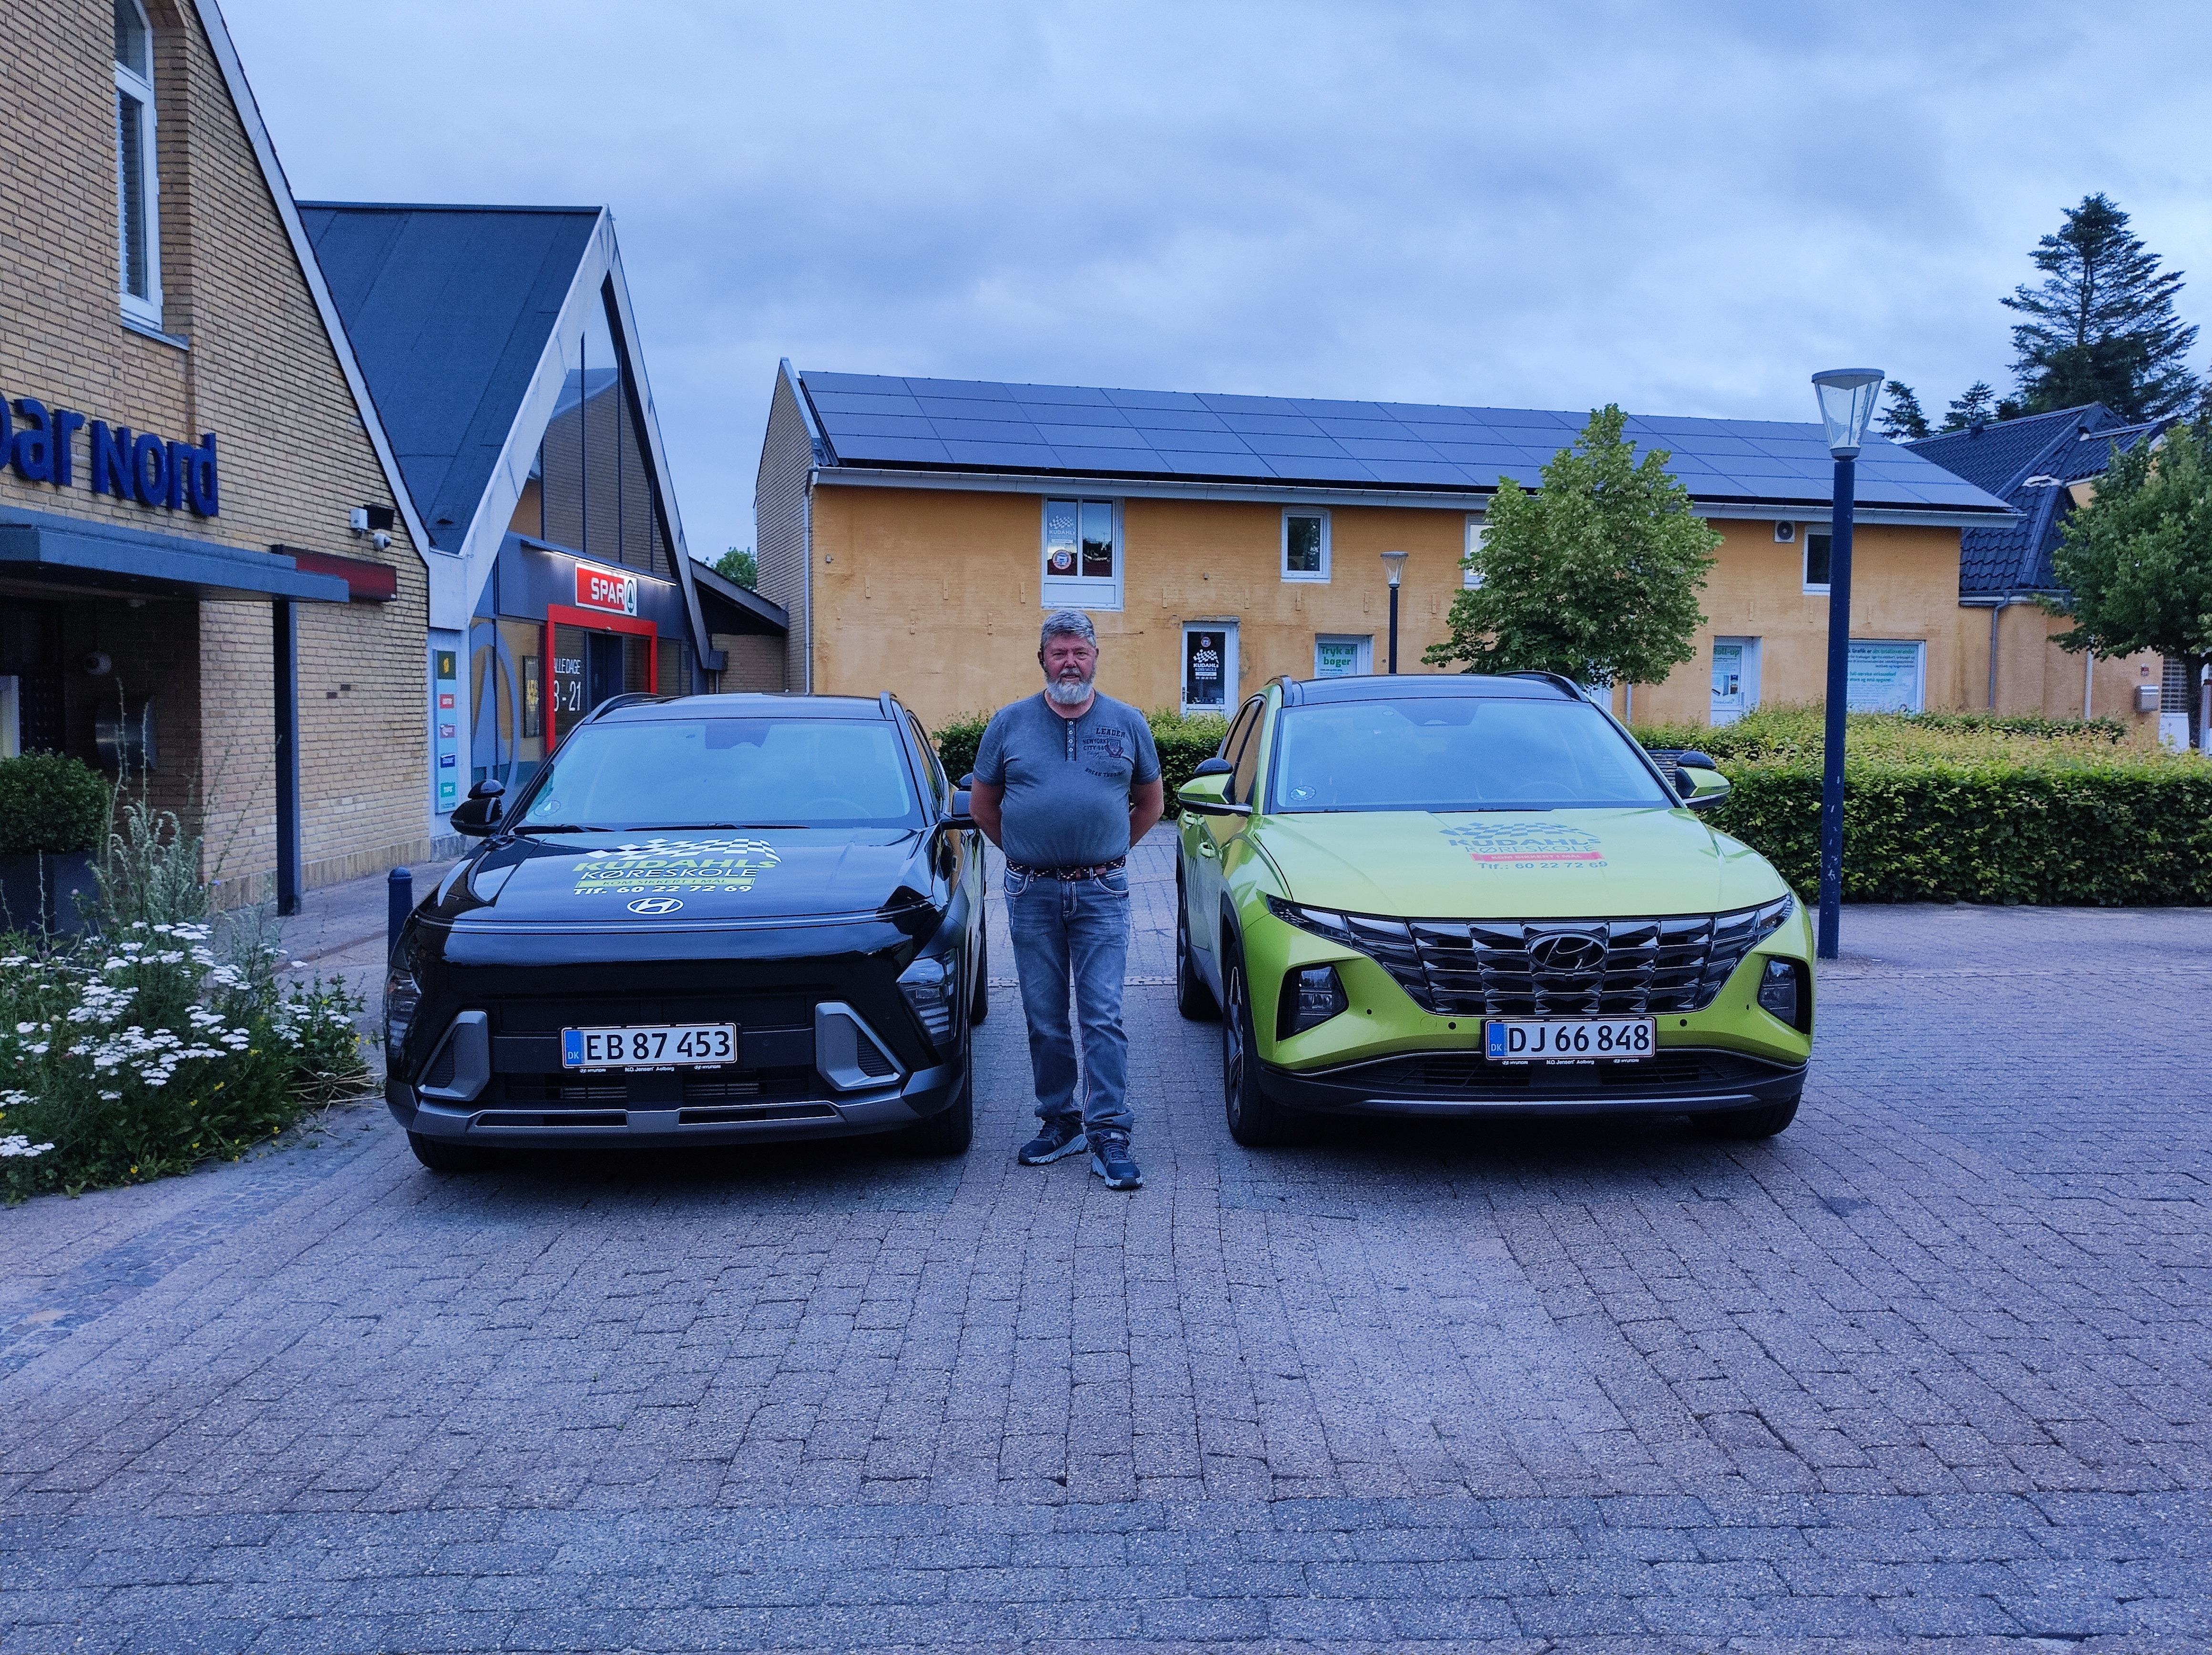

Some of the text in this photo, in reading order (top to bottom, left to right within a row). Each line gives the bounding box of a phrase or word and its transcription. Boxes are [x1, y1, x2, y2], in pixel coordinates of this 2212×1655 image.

[591, 576, 625, 605] SPAR
[1321, 646, 1355, 657] Tryk af
[569, 681, 581, 711] 21
[1096, 727, 1126, 738] LEADER
[1465, 845, 1597, 853] KØRESKOLE
[581, 868, 759, 880] KØRESKOLE
[573, 887, 608, 896] Tlf.
[1508, 1024, 1649, 1052] DJ 66 848
[586, 1031, 730, 1061] EB 87 453
[1491, 1043, 1502, 1052] DK
[567, 1051, 580, 1060] DK
